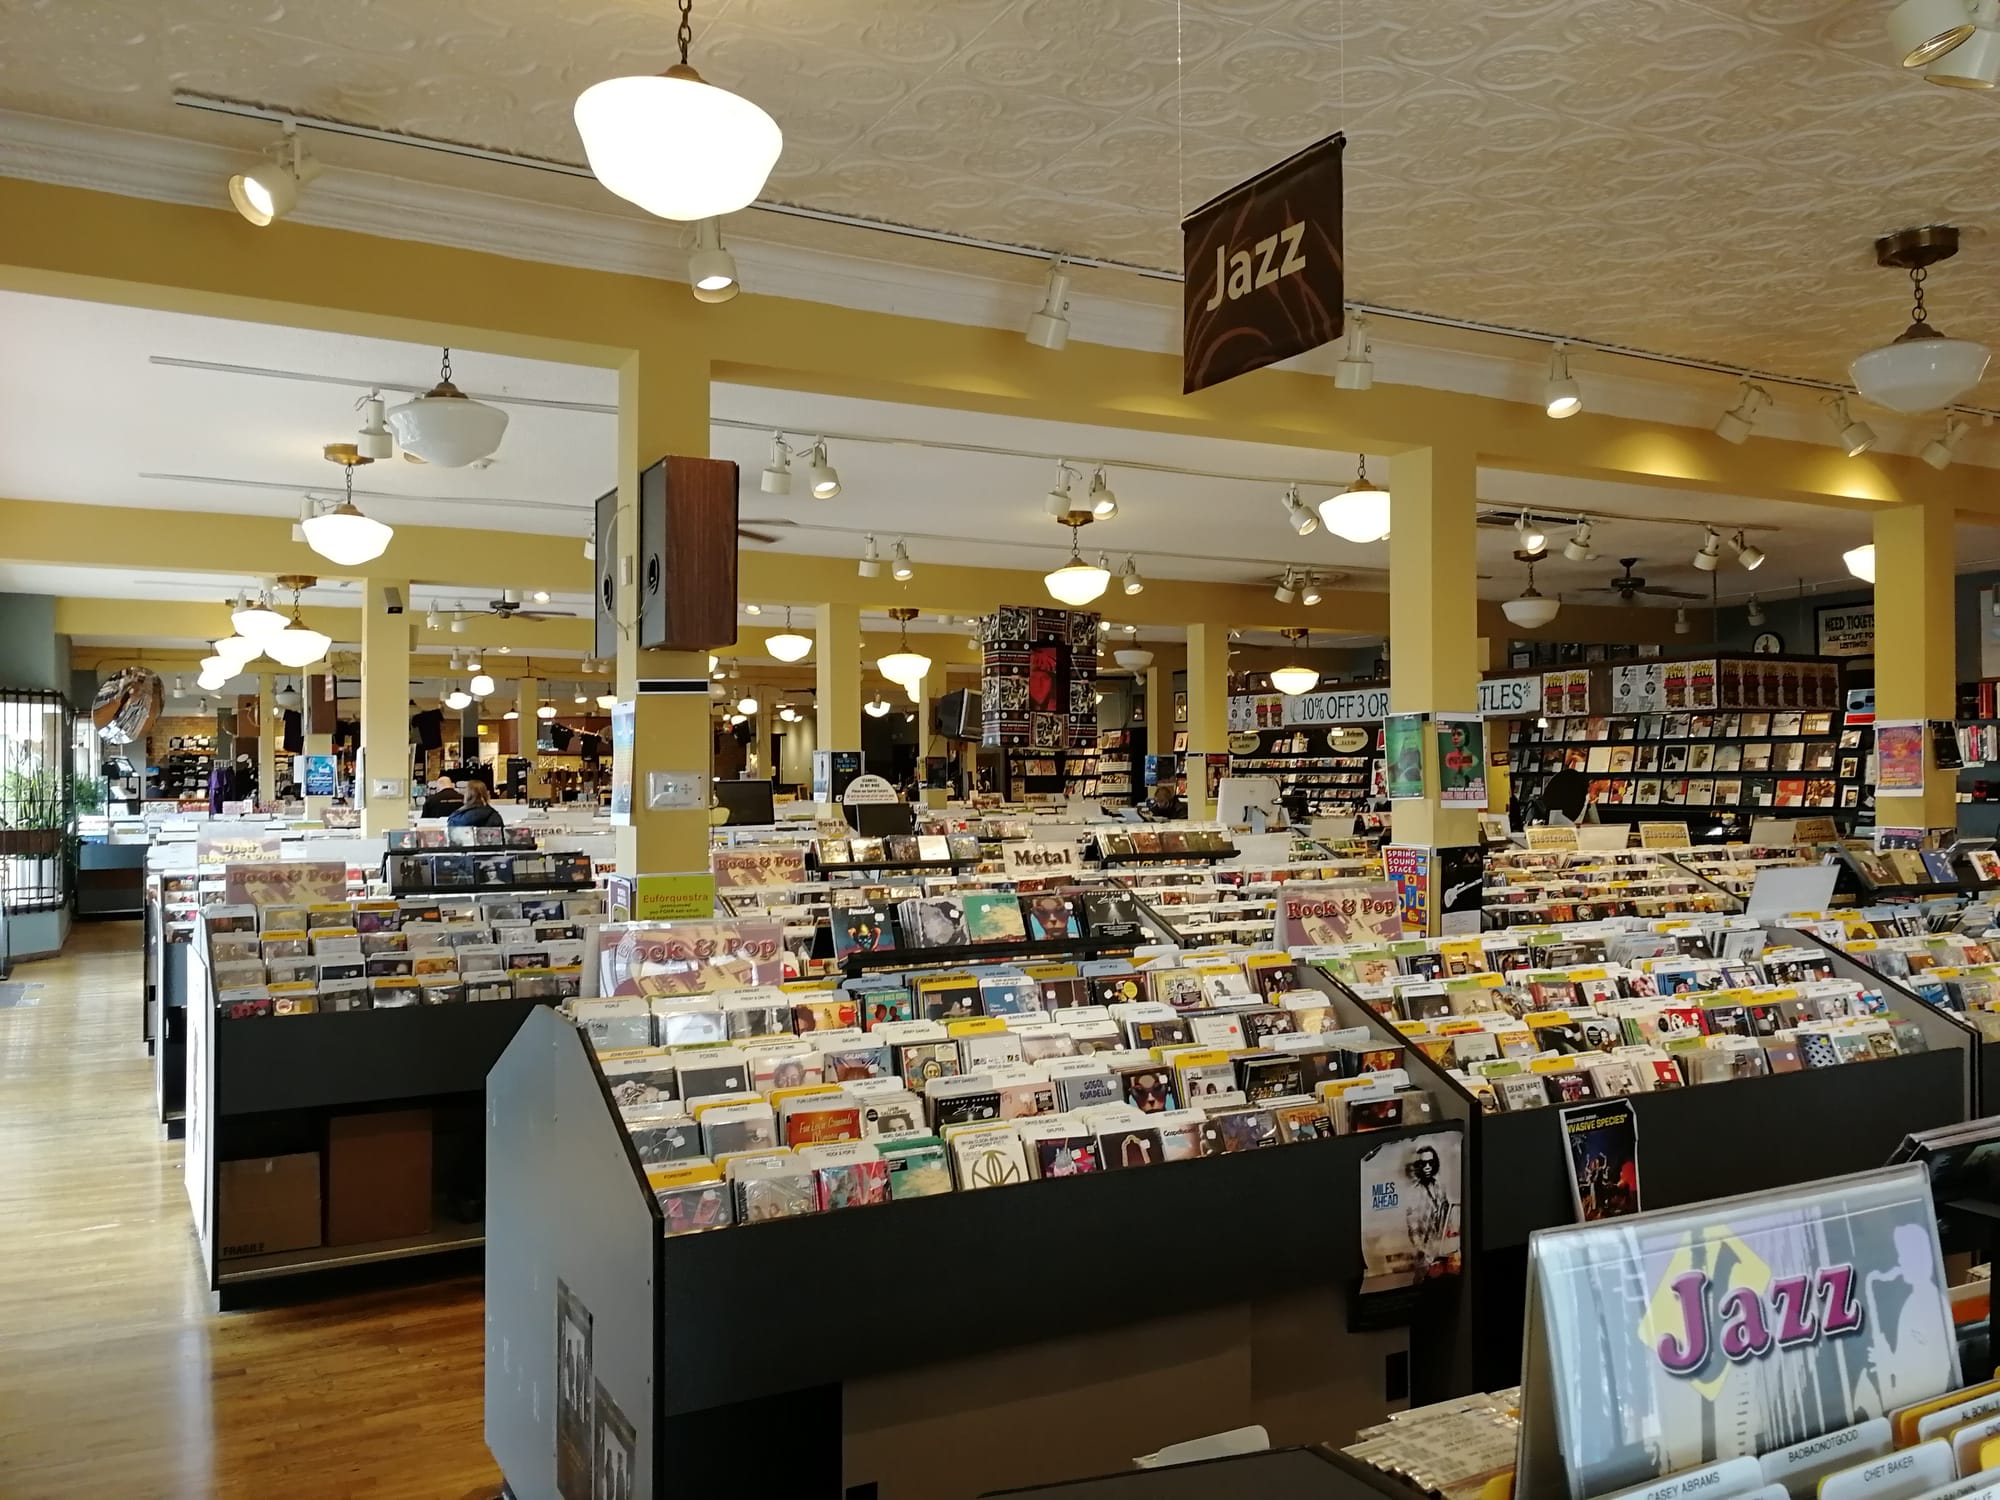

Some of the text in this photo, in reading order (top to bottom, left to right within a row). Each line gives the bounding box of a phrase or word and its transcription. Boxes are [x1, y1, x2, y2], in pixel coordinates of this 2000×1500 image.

[1206, 221, 1306, 312] Jazz
[1825, 616, 1845, 632] NEED
[1840, 641, 1867, 649] LISTINGS
[1480, 682, 1531, 712] TLES
[1302, 693, 1389, 720] 10% OFF 3 OR
[533, 828, 563, 837] ggae
[718, 856, 801, 871] Rock & Pop
[1014, 849, 1072, 866] Metal
[232, 869, 342, 882] Rock & Pop
[643, 893, 708, 904] Euforquestra
[1286, 898, 1396, 919] Rock & Pop
[610, 938, 777, 962] ock & Pop
[1084, 1080, 1105, 1089] GOGOL
[1507, 1081, 1541, 1093] GRANT HART
[1080, 1089, 1112, 1100] BORDELLO
[800, 1122, 810, 1133] Fun
[1567, 1120, 1595, 1134] NVASIVE
[1372, 1182, 1395, 1196] MILES
[1373, 1194, 1398, 1208] AHEAD
[223, 1242, 264, 1256] FRAGILE
[1657, 1261, 1864, 1378] Jazz
[1788, 1430, 1858, 1462] BADBADNOTGOOD
[1864, 1456, 1913, 1481] CHET BAKER
[1647, 1472, 1720, 1500] CASEY ABRAMS
